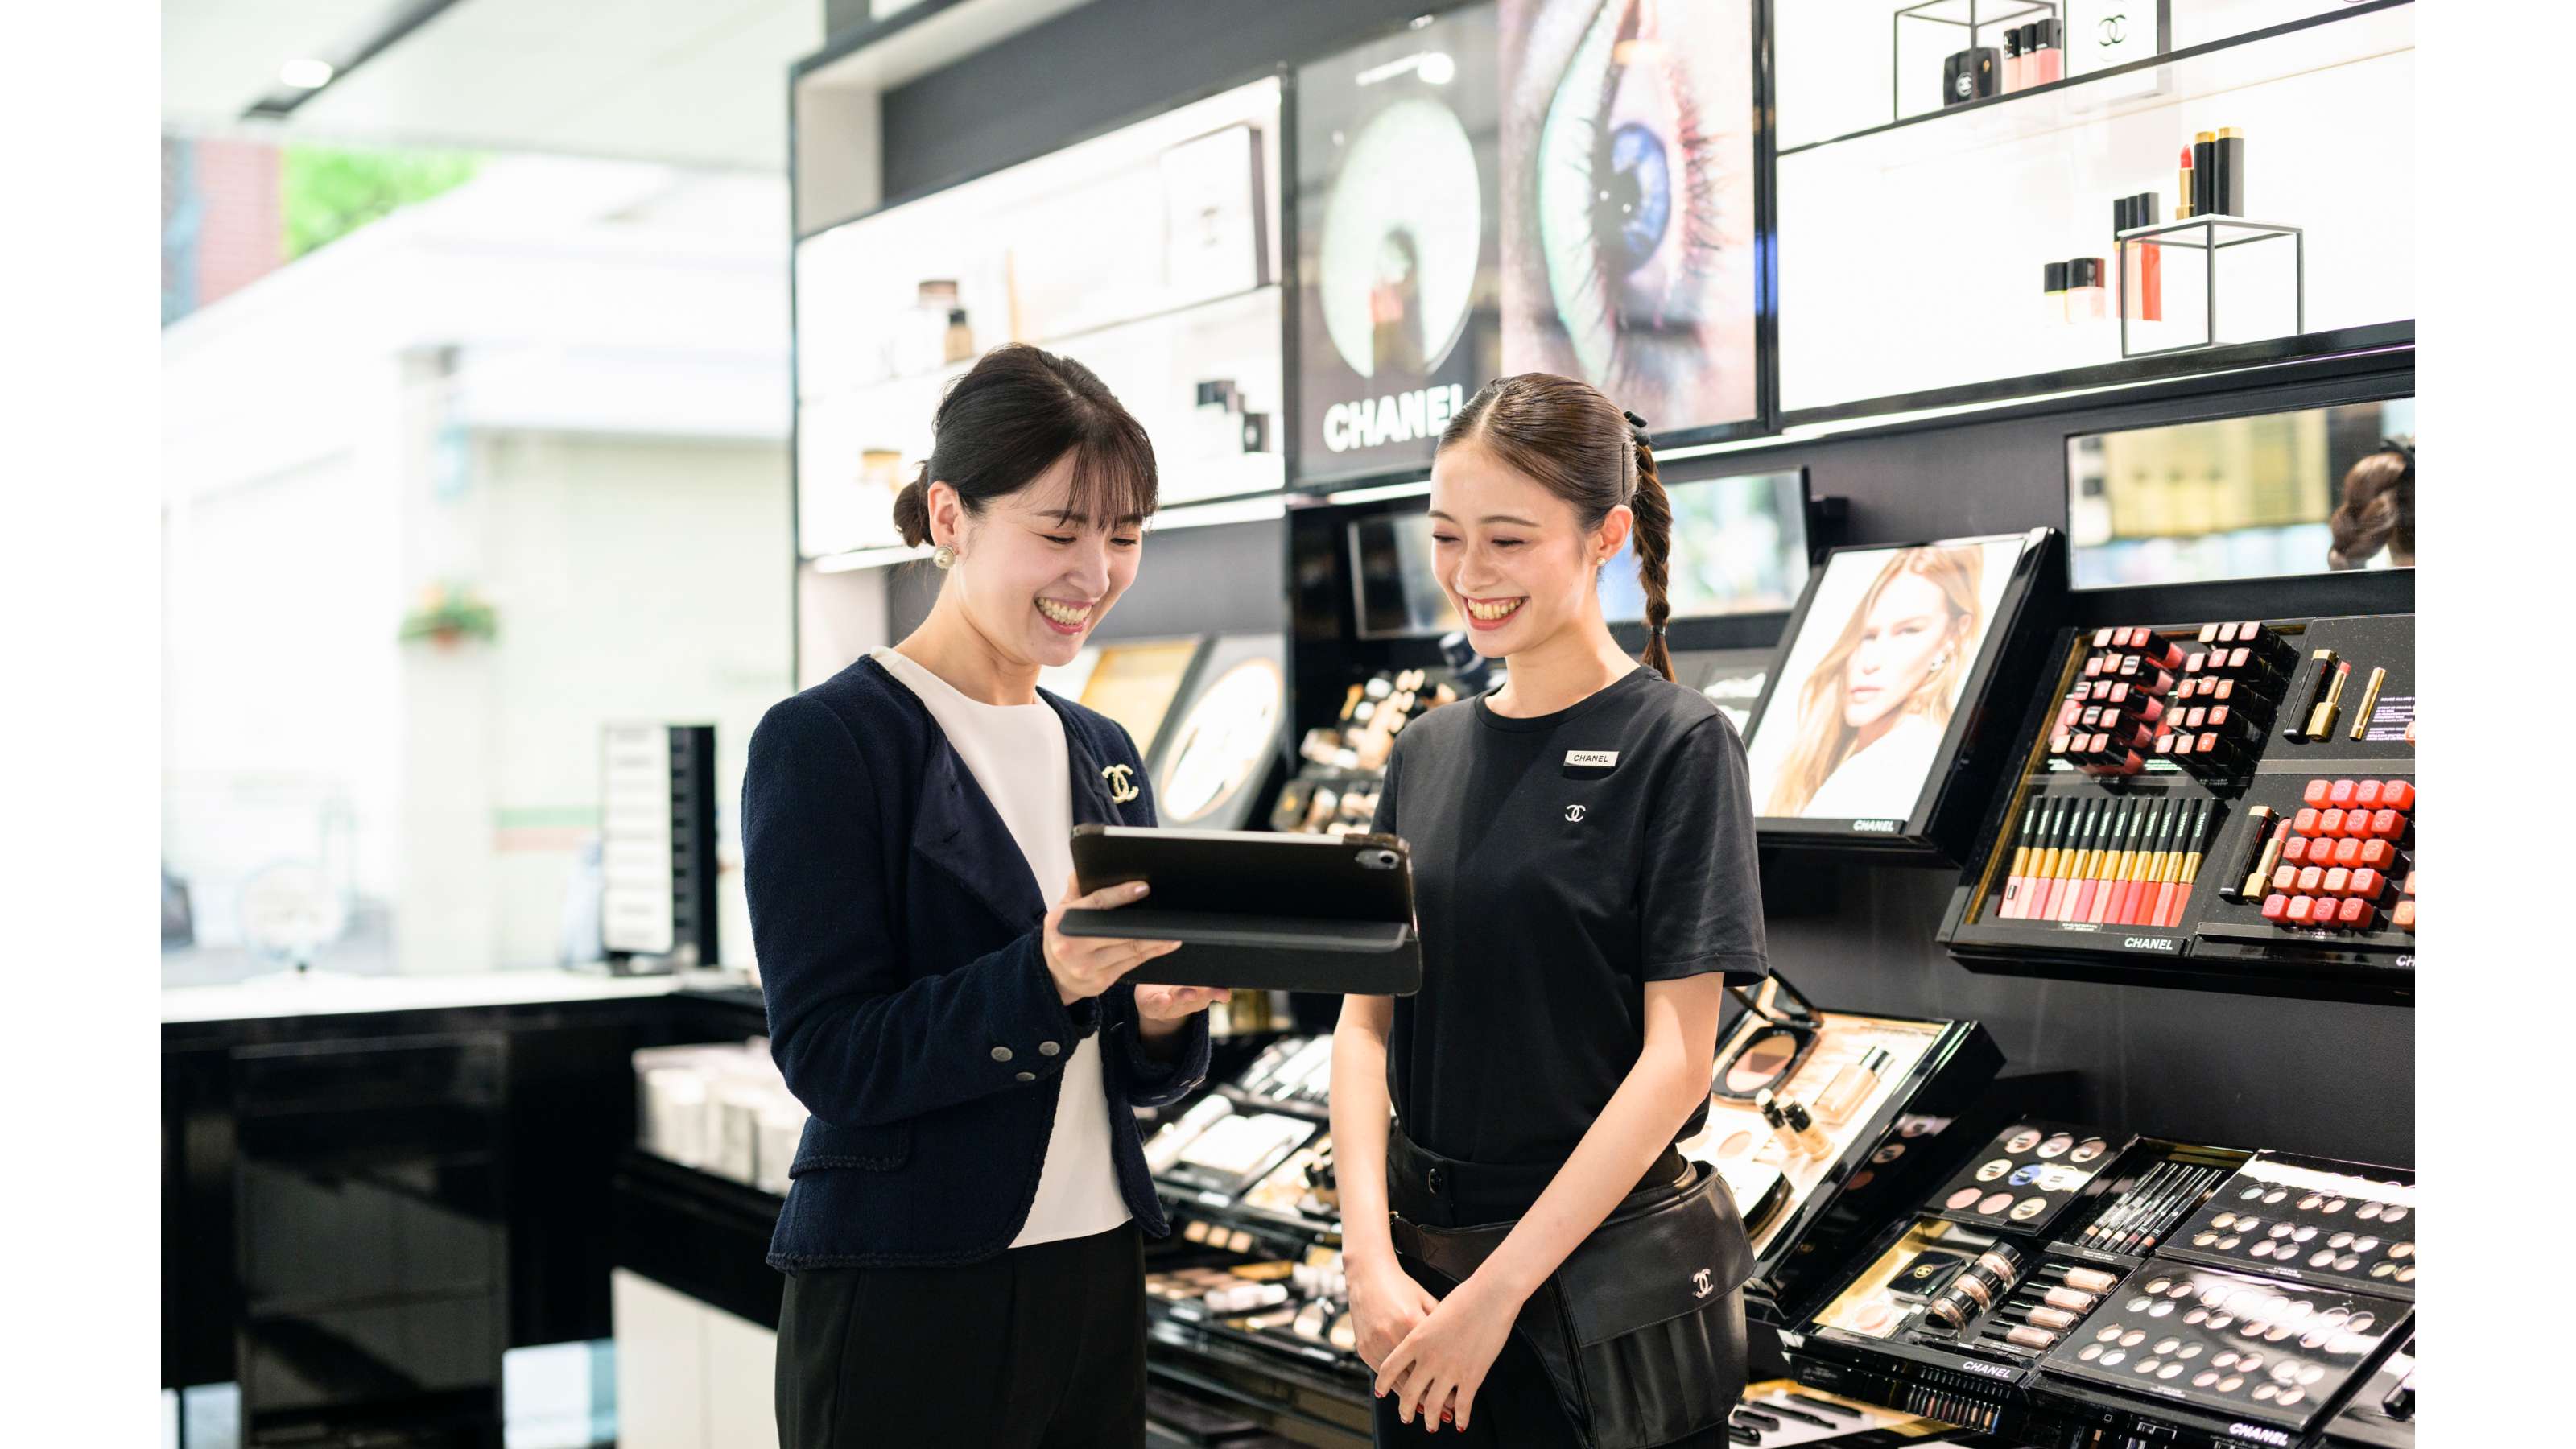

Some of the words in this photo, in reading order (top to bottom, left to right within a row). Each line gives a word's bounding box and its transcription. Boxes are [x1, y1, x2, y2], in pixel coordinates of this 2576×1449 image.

[1573, 754, 1608, 762] CHANEL
[1853, 819, 1894, 832] CHANEL
[2124, 937, 2174, 951] CHANEL
[1963, 1361, 2011, 1378] CHANEL
[2229, 1422, 2289, 1447] CHANEL
